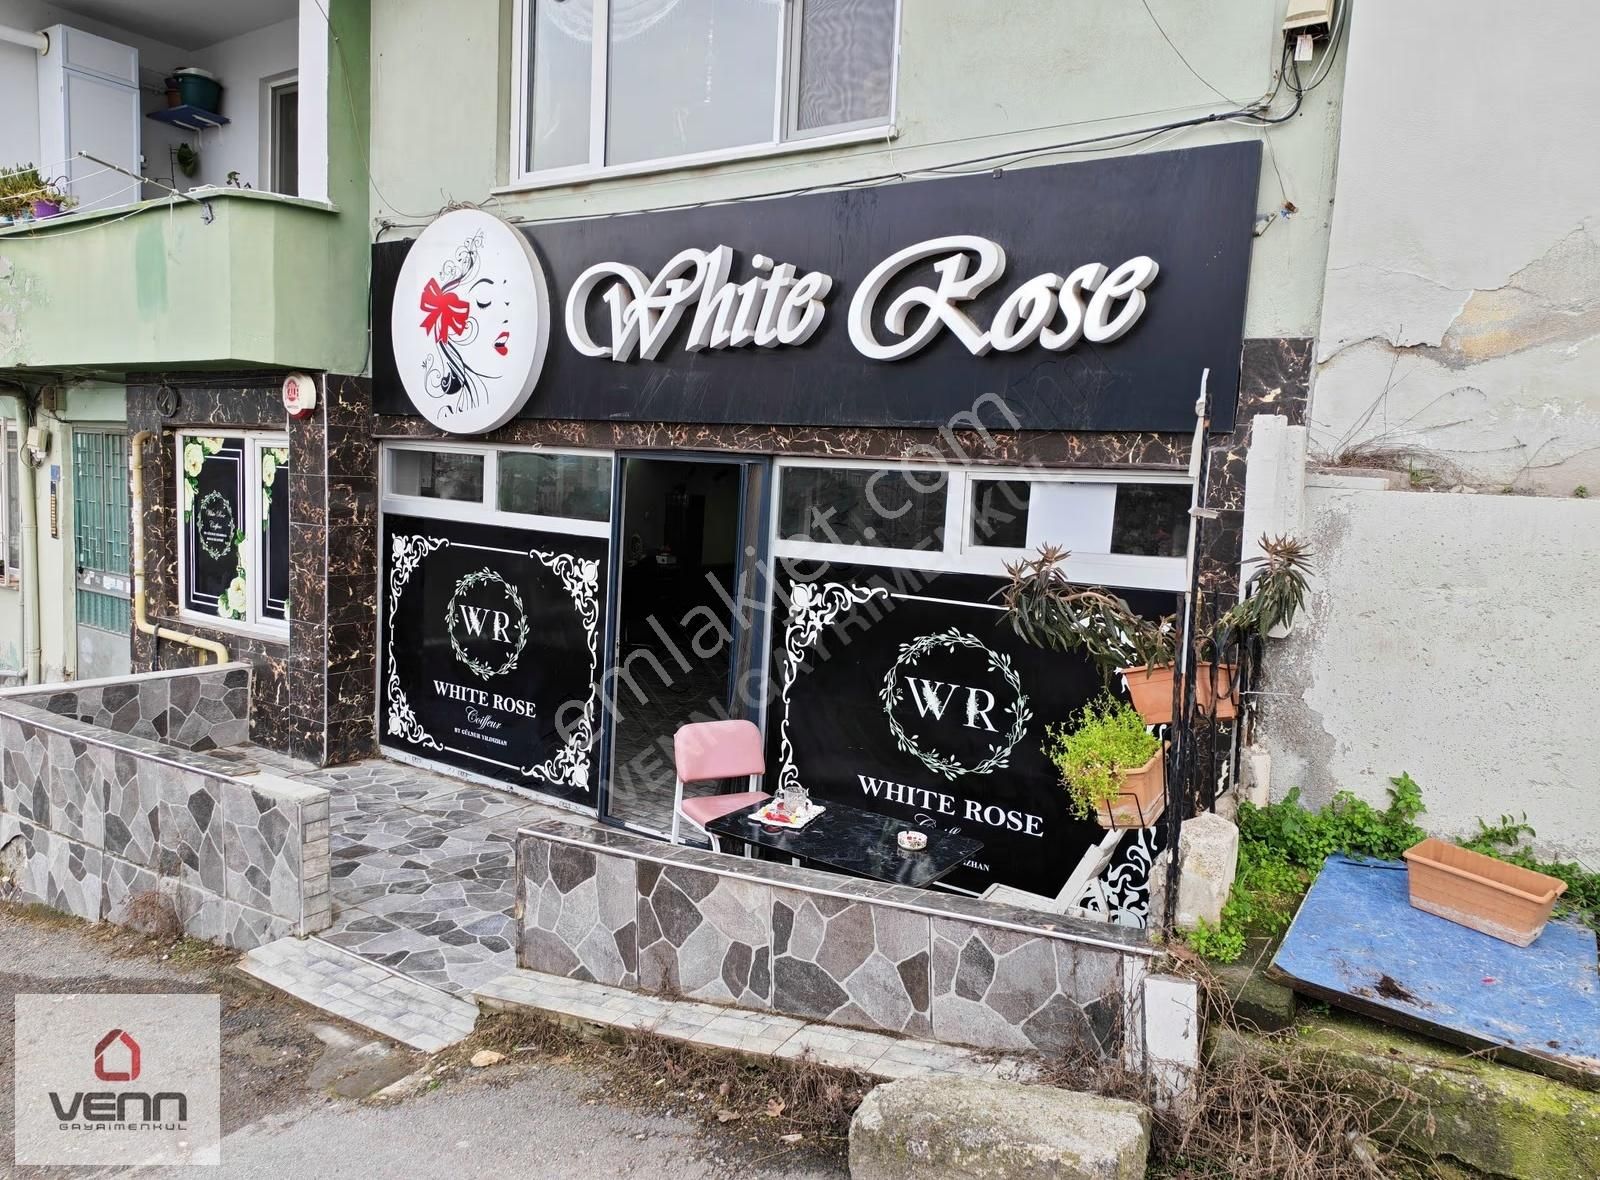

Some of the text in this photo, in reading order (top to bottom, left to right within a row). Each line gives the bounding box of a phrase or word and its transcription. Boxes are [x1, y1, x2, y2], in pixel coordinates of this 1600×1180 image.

[565, 235, 1160, 363] White Rose
[433, 680, 537, 719] WHITE ROSE
[465, 706, 502, 730] Coiffeur
[857, 774, 956, 816] WHITE
[963, 799, 1045, 838] ROSE
